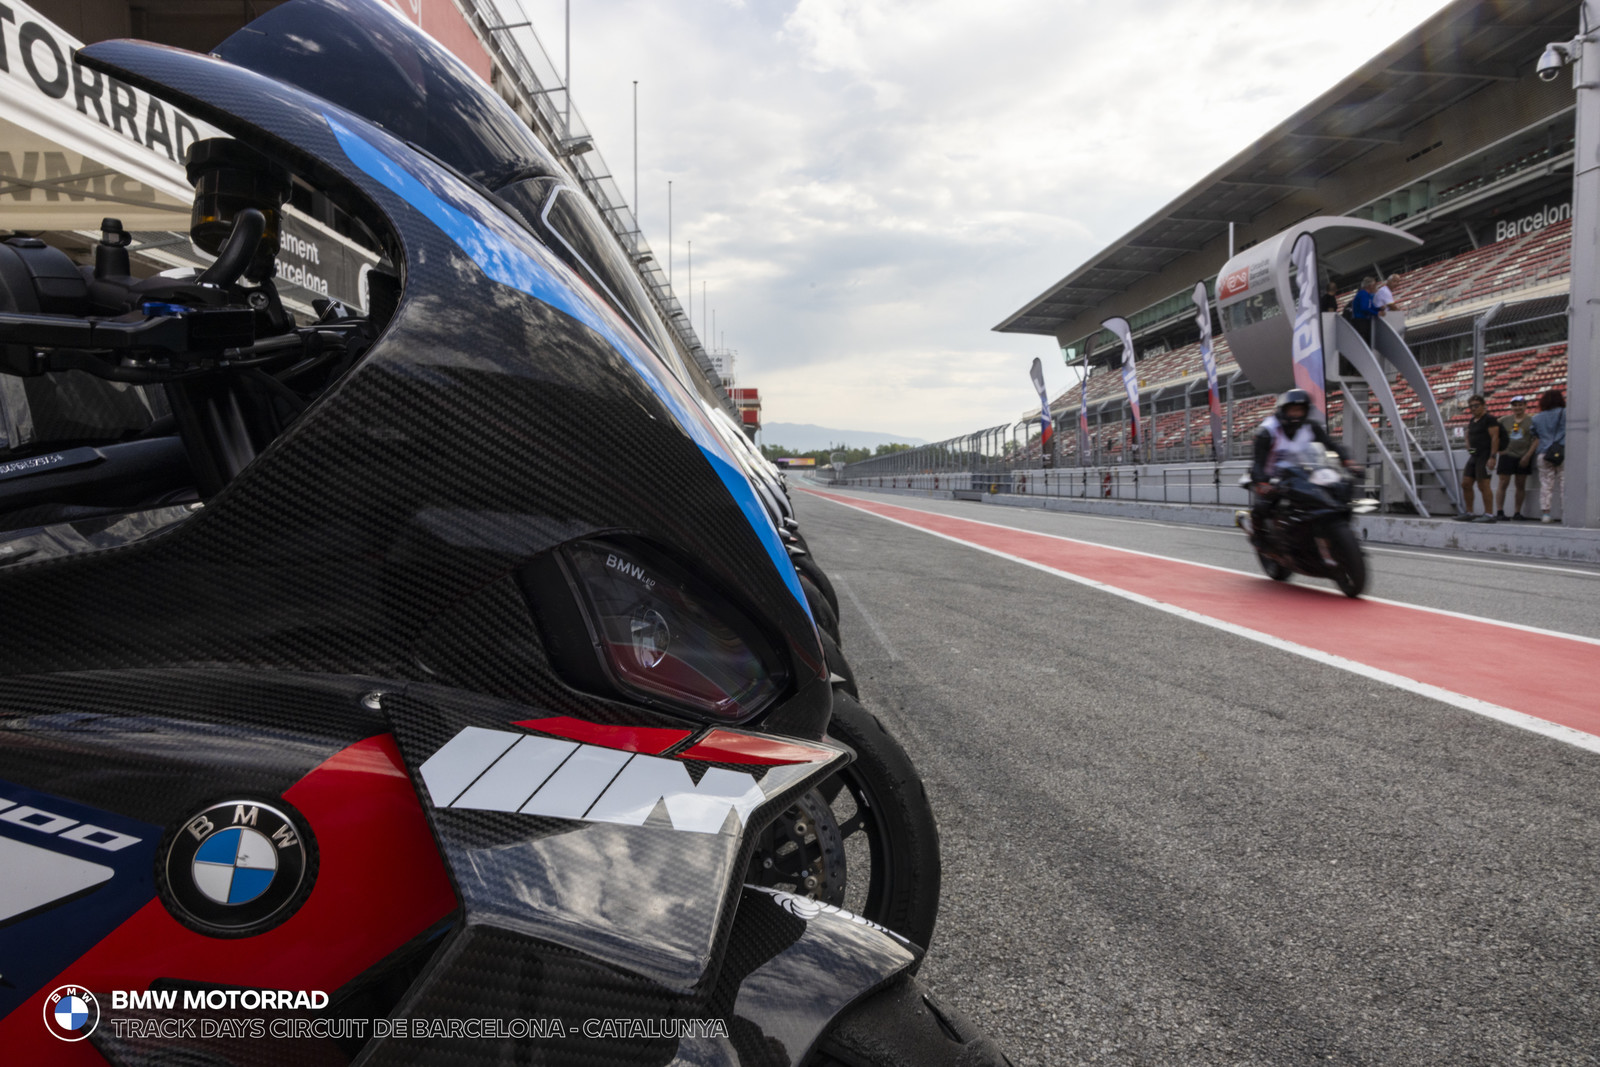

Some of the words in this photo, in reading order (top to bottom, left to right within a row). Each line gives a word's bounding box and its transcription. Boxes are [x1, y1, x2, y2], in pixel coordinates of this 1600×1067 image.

[1496, 203, 1574, 242] Barcelon
[275, 258, 328, 296] arcelona
[606, 553, 645, 580] BMW
[0, 797, 143, 852] 00
[187, 804, 299, 849] BMW
